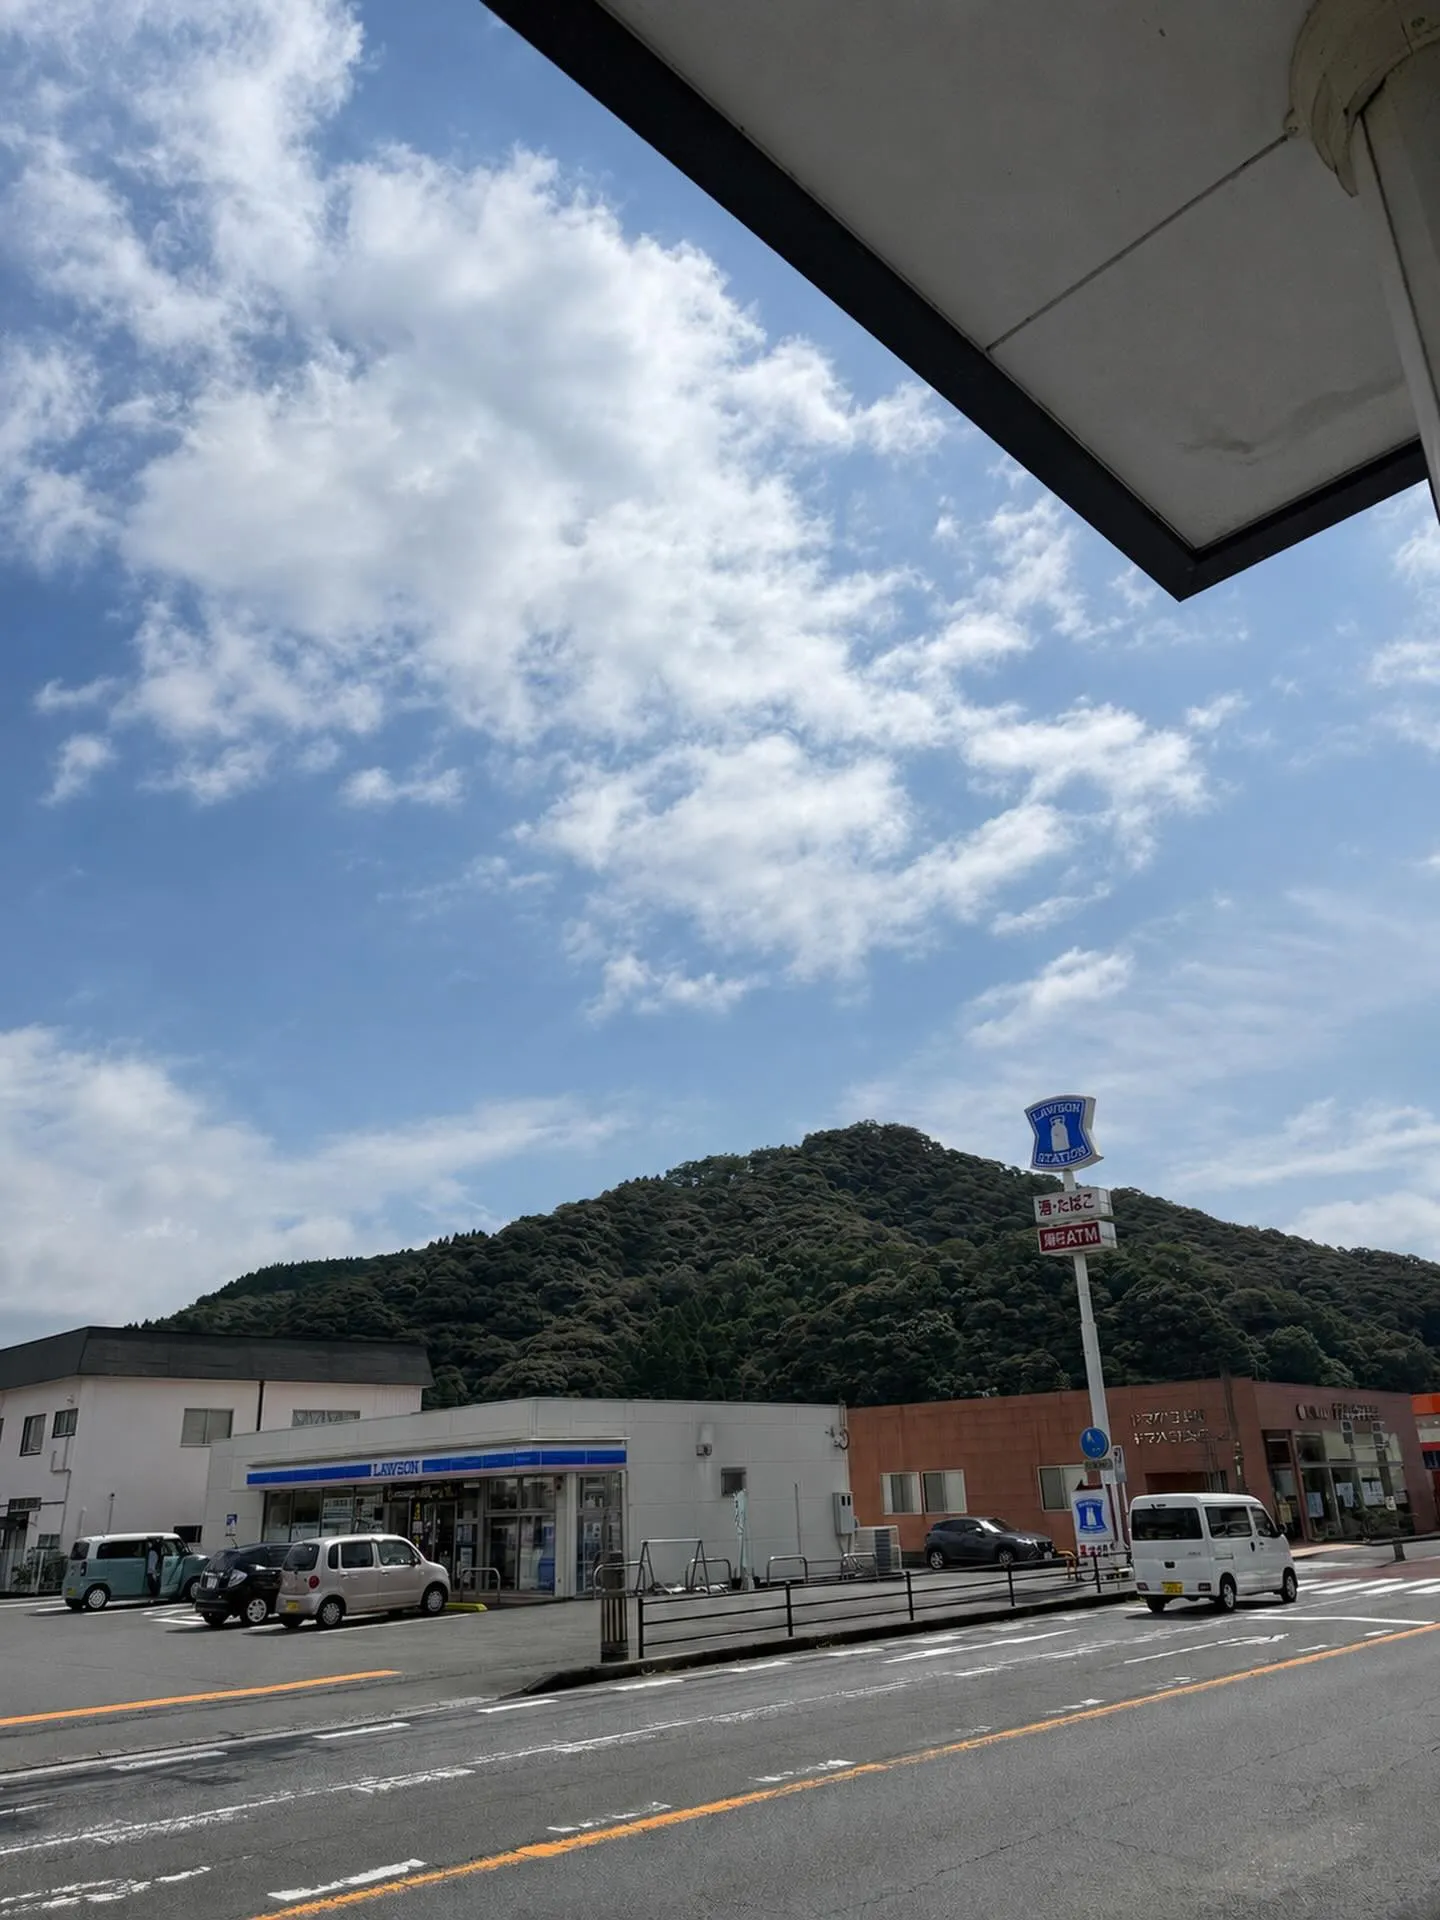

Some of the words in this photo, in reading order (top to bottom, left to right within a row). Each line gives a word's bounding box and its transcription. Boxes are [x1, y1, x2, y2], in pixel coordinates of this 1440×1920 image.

[1032, 1103, 1081, 1121] LAWSON
[1037, 1146, 1086, 1163] STATION
[1038, 1194, 1094, 1216] 酒・たばこ
[373, 1460, 420, 1477] LAWSON
